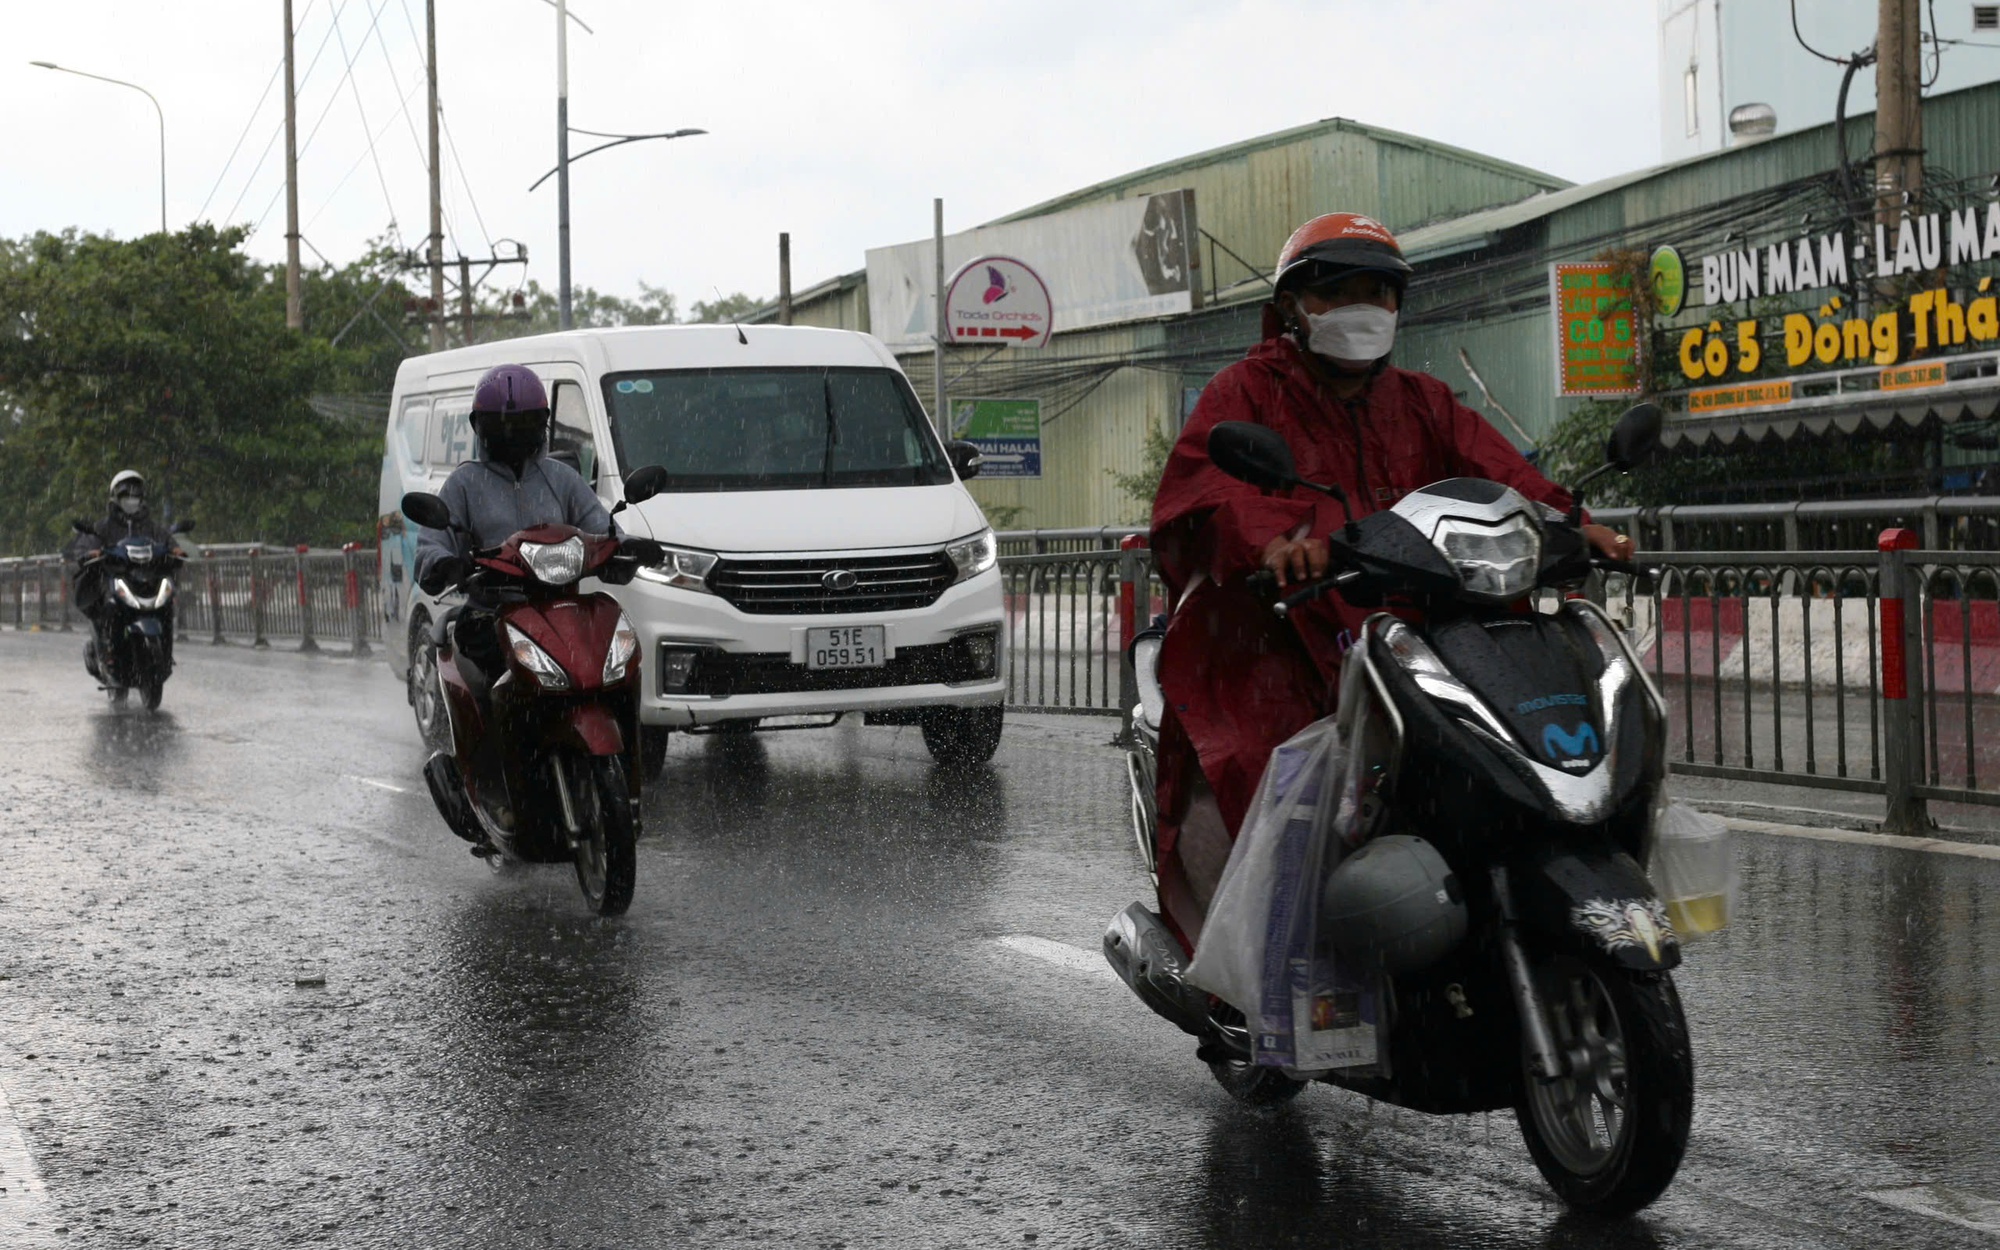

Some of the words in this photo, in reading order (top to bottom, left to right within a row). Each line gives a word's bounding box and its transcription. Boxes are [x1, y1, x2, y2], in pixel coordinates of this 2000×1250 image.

[957, 310, 989, 320] Toda
[992, 310, 1043, 321] Orchids
[1570, 315, 1604, 342] CÔ
[1615, 319, 1630, 341] 5
[1680, 321, 1729, 379] Cô
[1737, 320, 1761, 373] 5
[1783, 296, 1900, 367] Đồng
[1000, 443, 1039, 453] HALAL
[829, 628, 863, 646] 51E
[816, 647, 875, 665] 059.51
